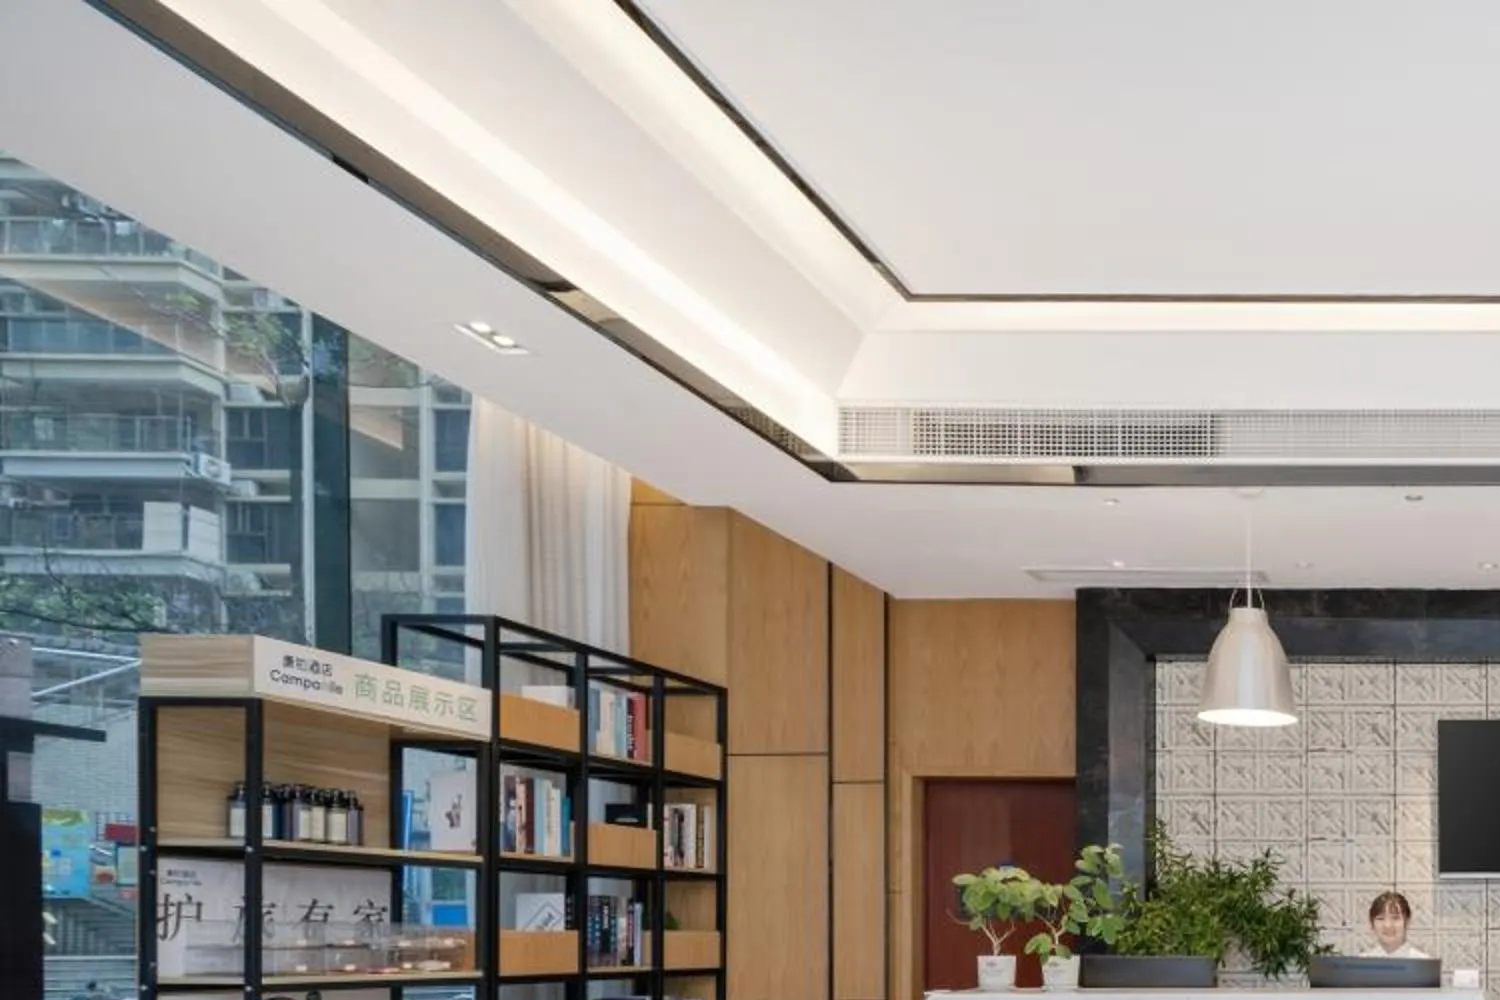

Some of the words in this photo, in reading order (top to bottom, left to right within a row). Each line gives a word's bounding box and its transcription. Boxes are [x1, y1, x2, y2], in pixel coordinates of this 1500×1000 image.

[270, 669, 343, 695] Campale
[354, 671, 477, 723] 商品展示区
